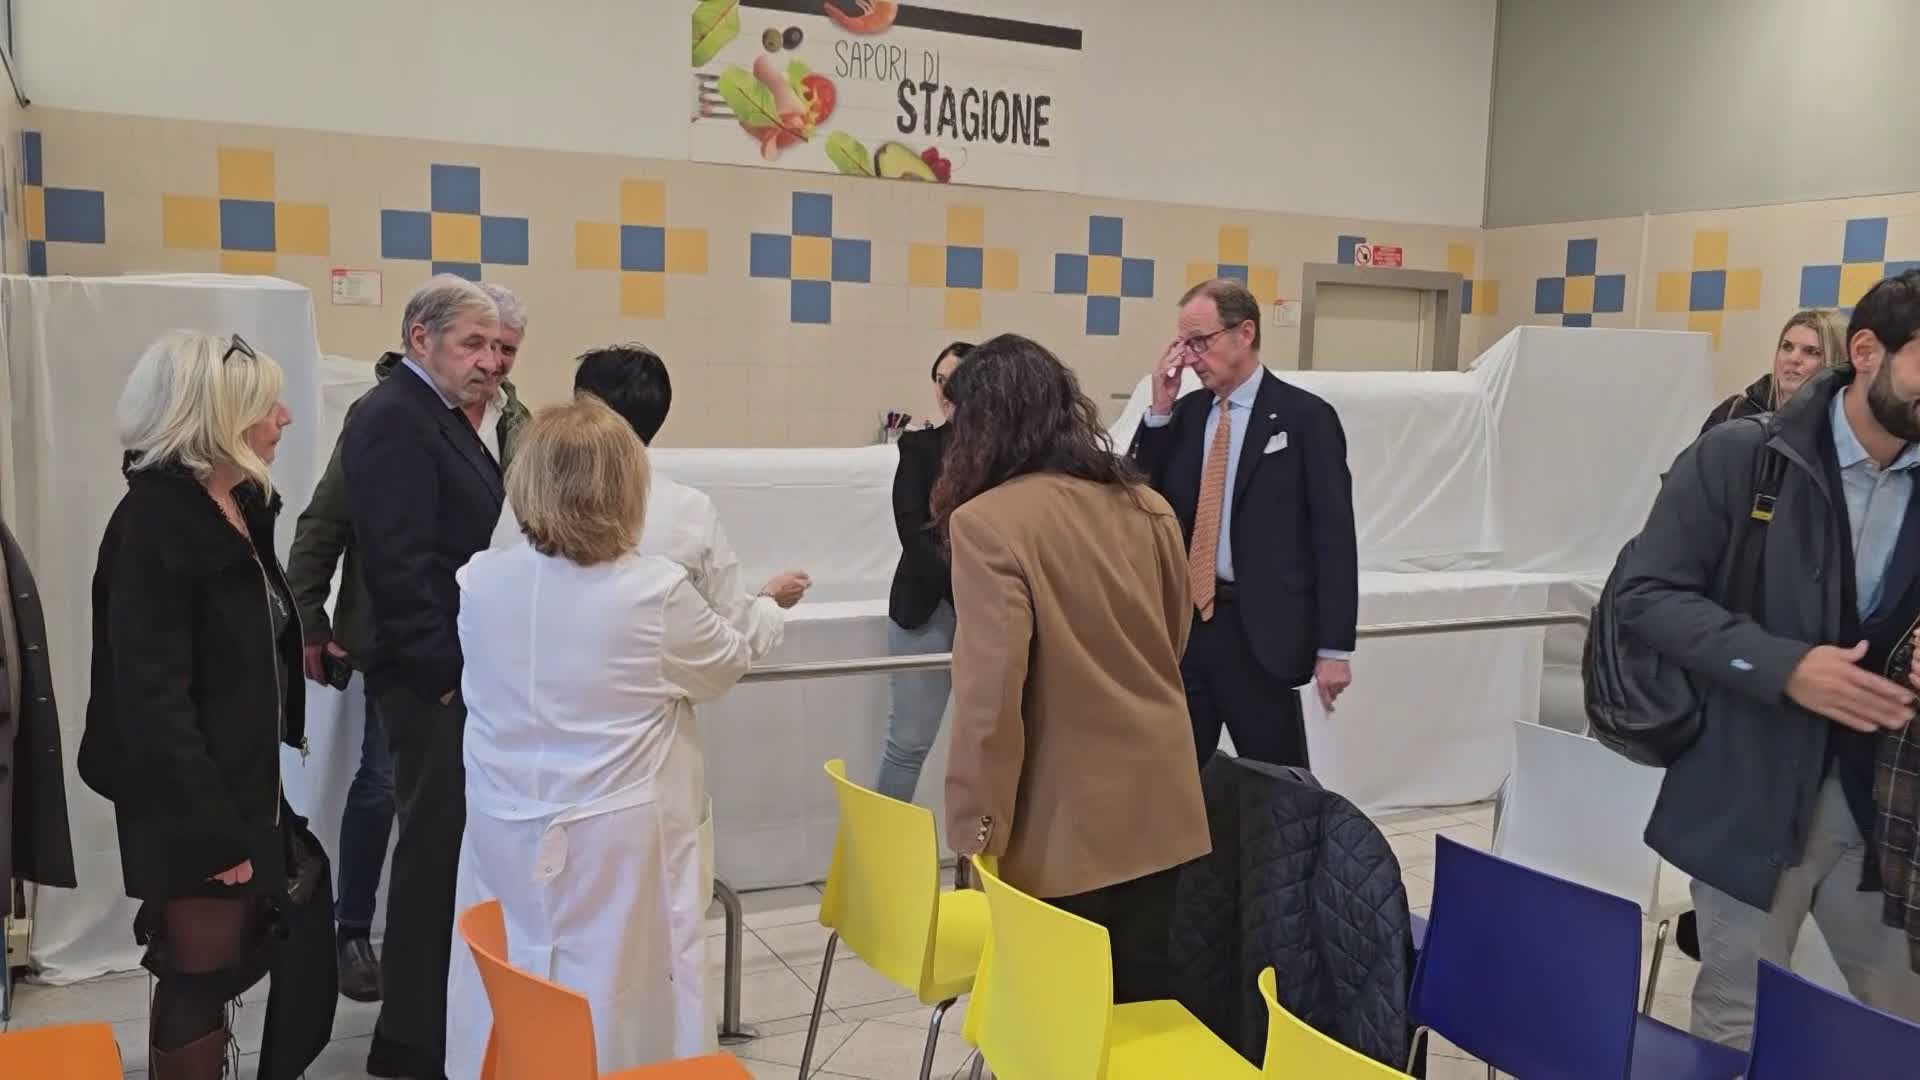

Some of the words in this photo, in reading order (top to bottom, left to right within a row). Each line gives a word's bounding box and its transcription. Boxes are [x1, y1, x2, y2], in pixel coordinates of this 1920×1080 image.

[834, 39, 908, 82] SAPORI
[923, 51, 941, 84] DI
[896, 78, 1052, 148] STAGIONE
